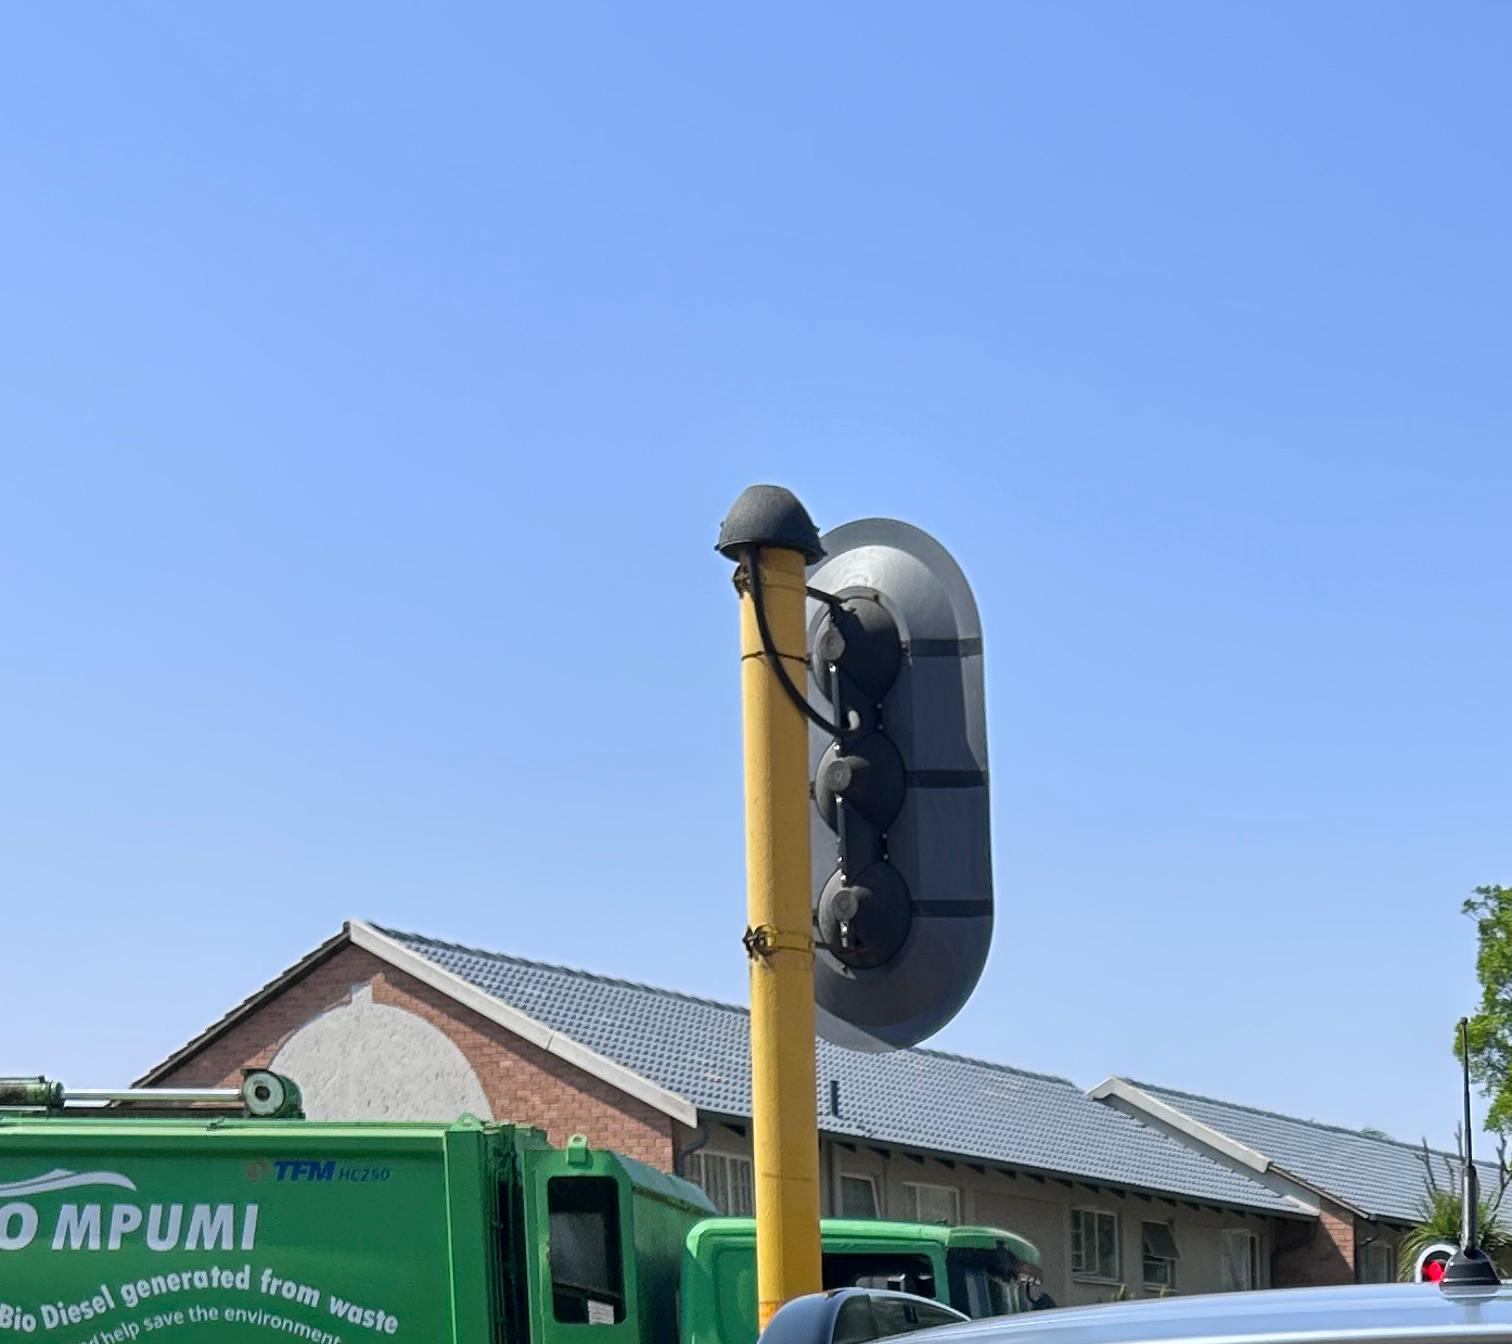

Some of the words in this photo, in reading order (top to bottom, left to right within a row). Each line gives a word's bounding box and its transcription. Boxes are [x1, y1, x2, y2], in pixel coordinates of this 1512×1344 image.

[273, 1159, 337, 1182] TFM
[51, 1203, 259, 1251] MPUMI
[0, 1302, 37, 1333] Bio
[40, 1284, 116, 1330] Diesel
[120, 1264, 251, 1309] generated
[260, 1268, 321, 1308] from
[329, 1295, 399, 1334] waste
[143, 1309, 185, 1332] save
[188, 1304, 219, 1323] the
